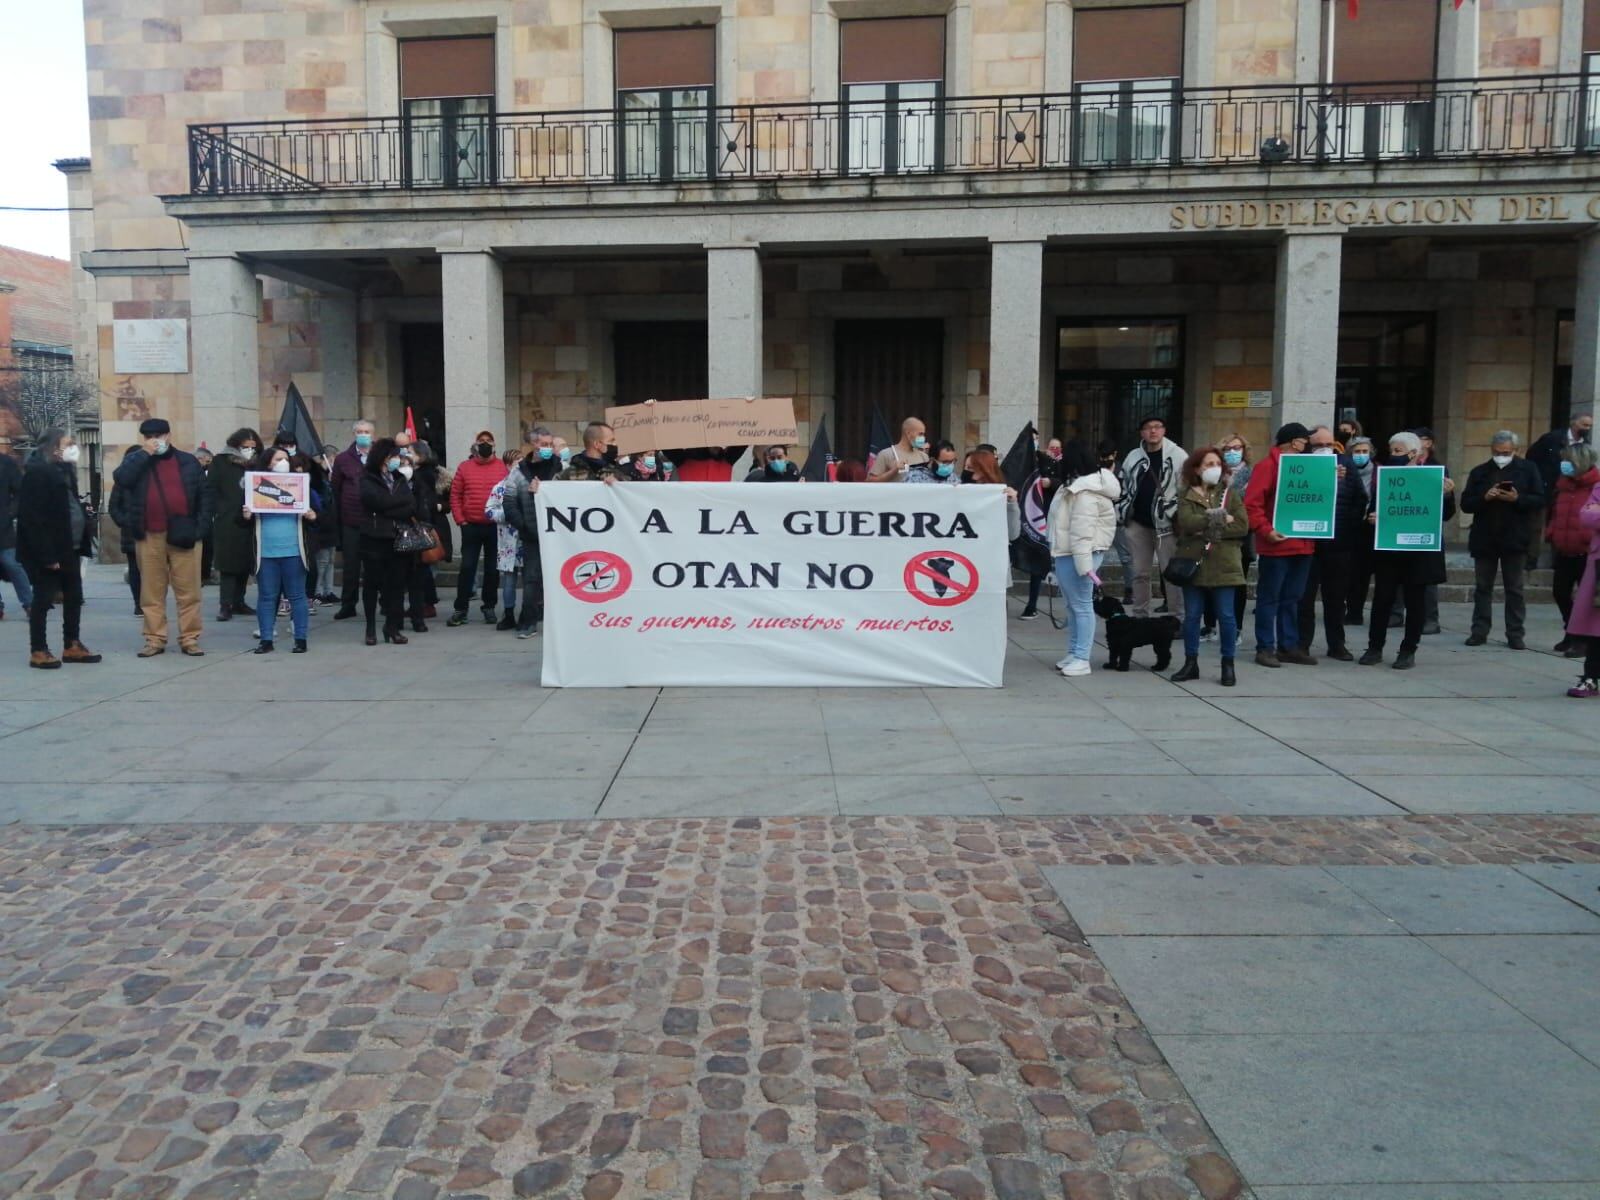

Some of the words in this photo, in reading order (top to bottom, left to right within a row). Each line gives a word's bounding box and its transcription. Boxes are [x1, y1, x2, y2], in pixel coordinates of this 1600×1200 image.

[1169, 197, 1474, 230] SUBDELEGACION
[1500, 196, 1570, 221] DEL
[1289, 464, 1304, 475] NO
[1288, 479, 1295, 489] A
[1297, 479, 1309, 489] LA
[1388, 477, 1406, 488] NO
[1286, 493, 1324, 504] GUERRA
[1388, 492, 1396, 501] A
[1400, 492, 1411, 501] LA
[1387, 505, 1430, 516] GUERRA
[545, 506, 615, 533] NO
[640, 508, 672, 534] A
[698, 508, 759, 535] LA
[783, 510, 979, 538] GUERRA
[652, 561, 781, 588] OTAN
[806, 562, 873, 589] NO
[589, 612, 632, 629] Sus
[637, 613, 736, 632] guerras,
[747, 614, 845, 631] nuestros
[855, 615, 955, 632] muertos.
